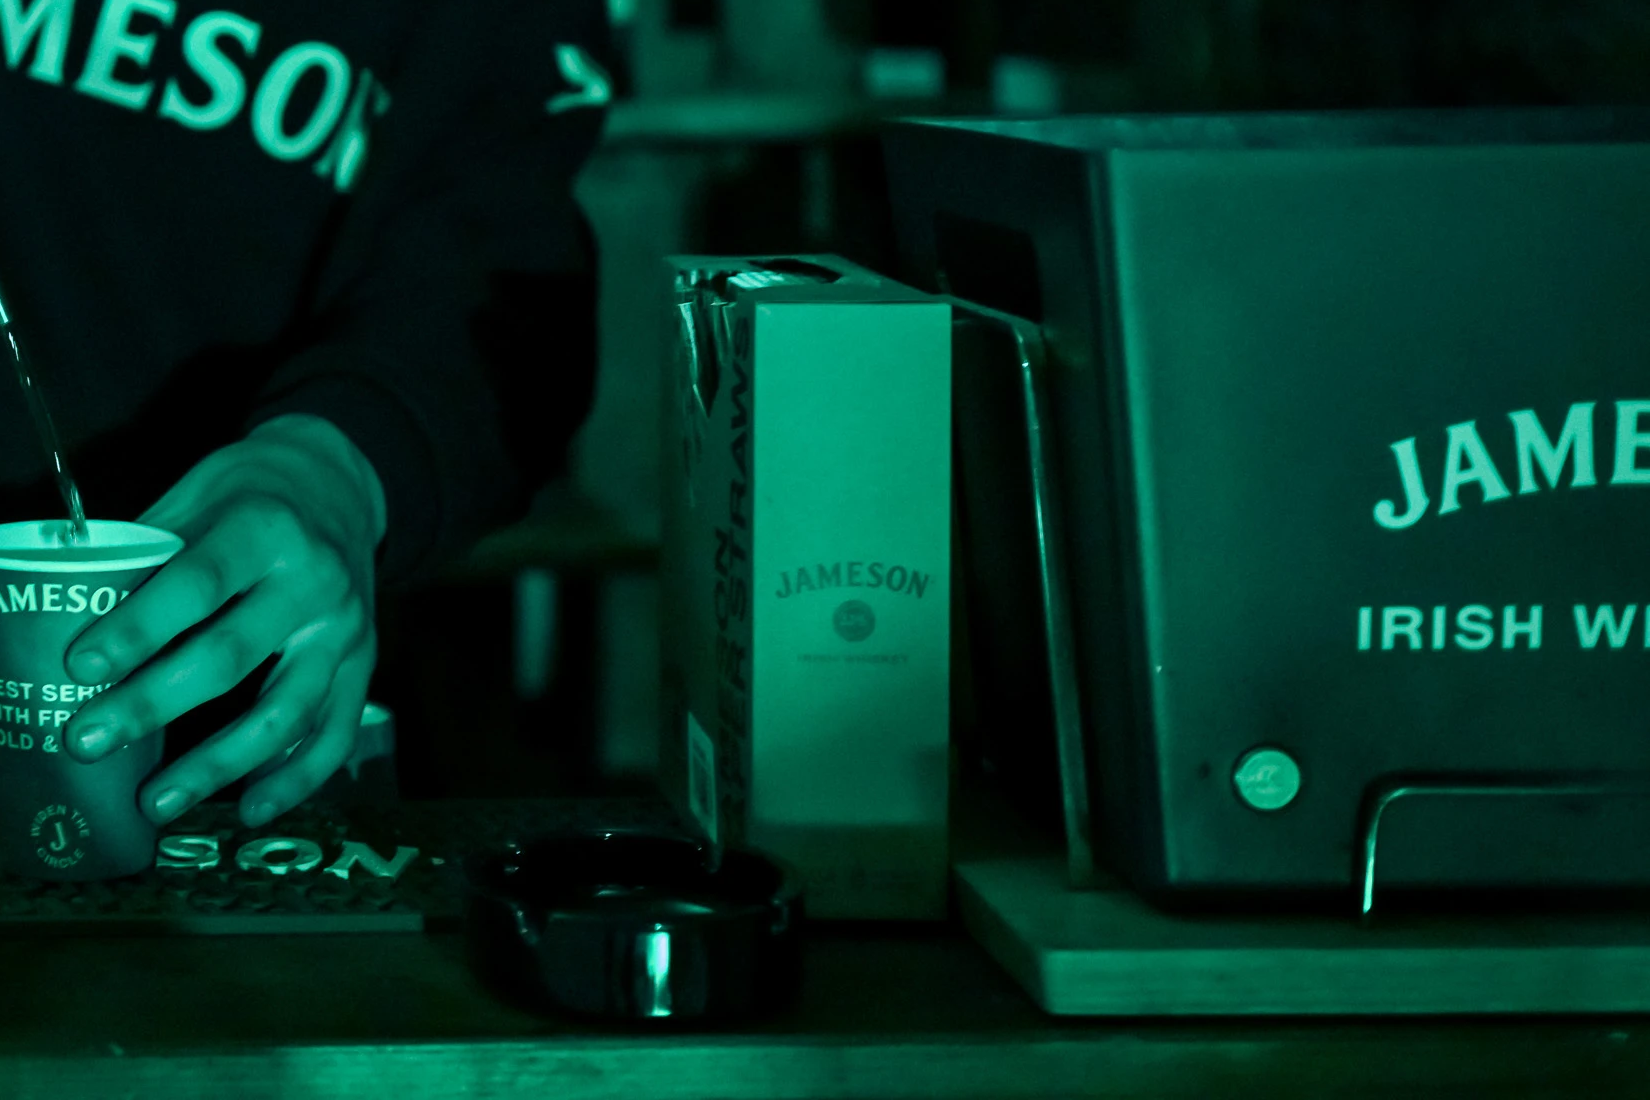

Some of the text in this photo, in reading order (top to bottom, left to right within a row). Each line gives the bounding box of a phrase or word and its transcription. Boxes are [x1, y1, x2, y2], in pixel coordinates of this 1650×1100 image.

[775, 562, 930, 599] JAMESON
[1358, 605, 1543, 650] IRISH
[42, 734, 59, 753] &
[50, 821, 66, 851] J
[71, 808, 90, 837] THE
[36, 847, 85, 869] CIRCLE
